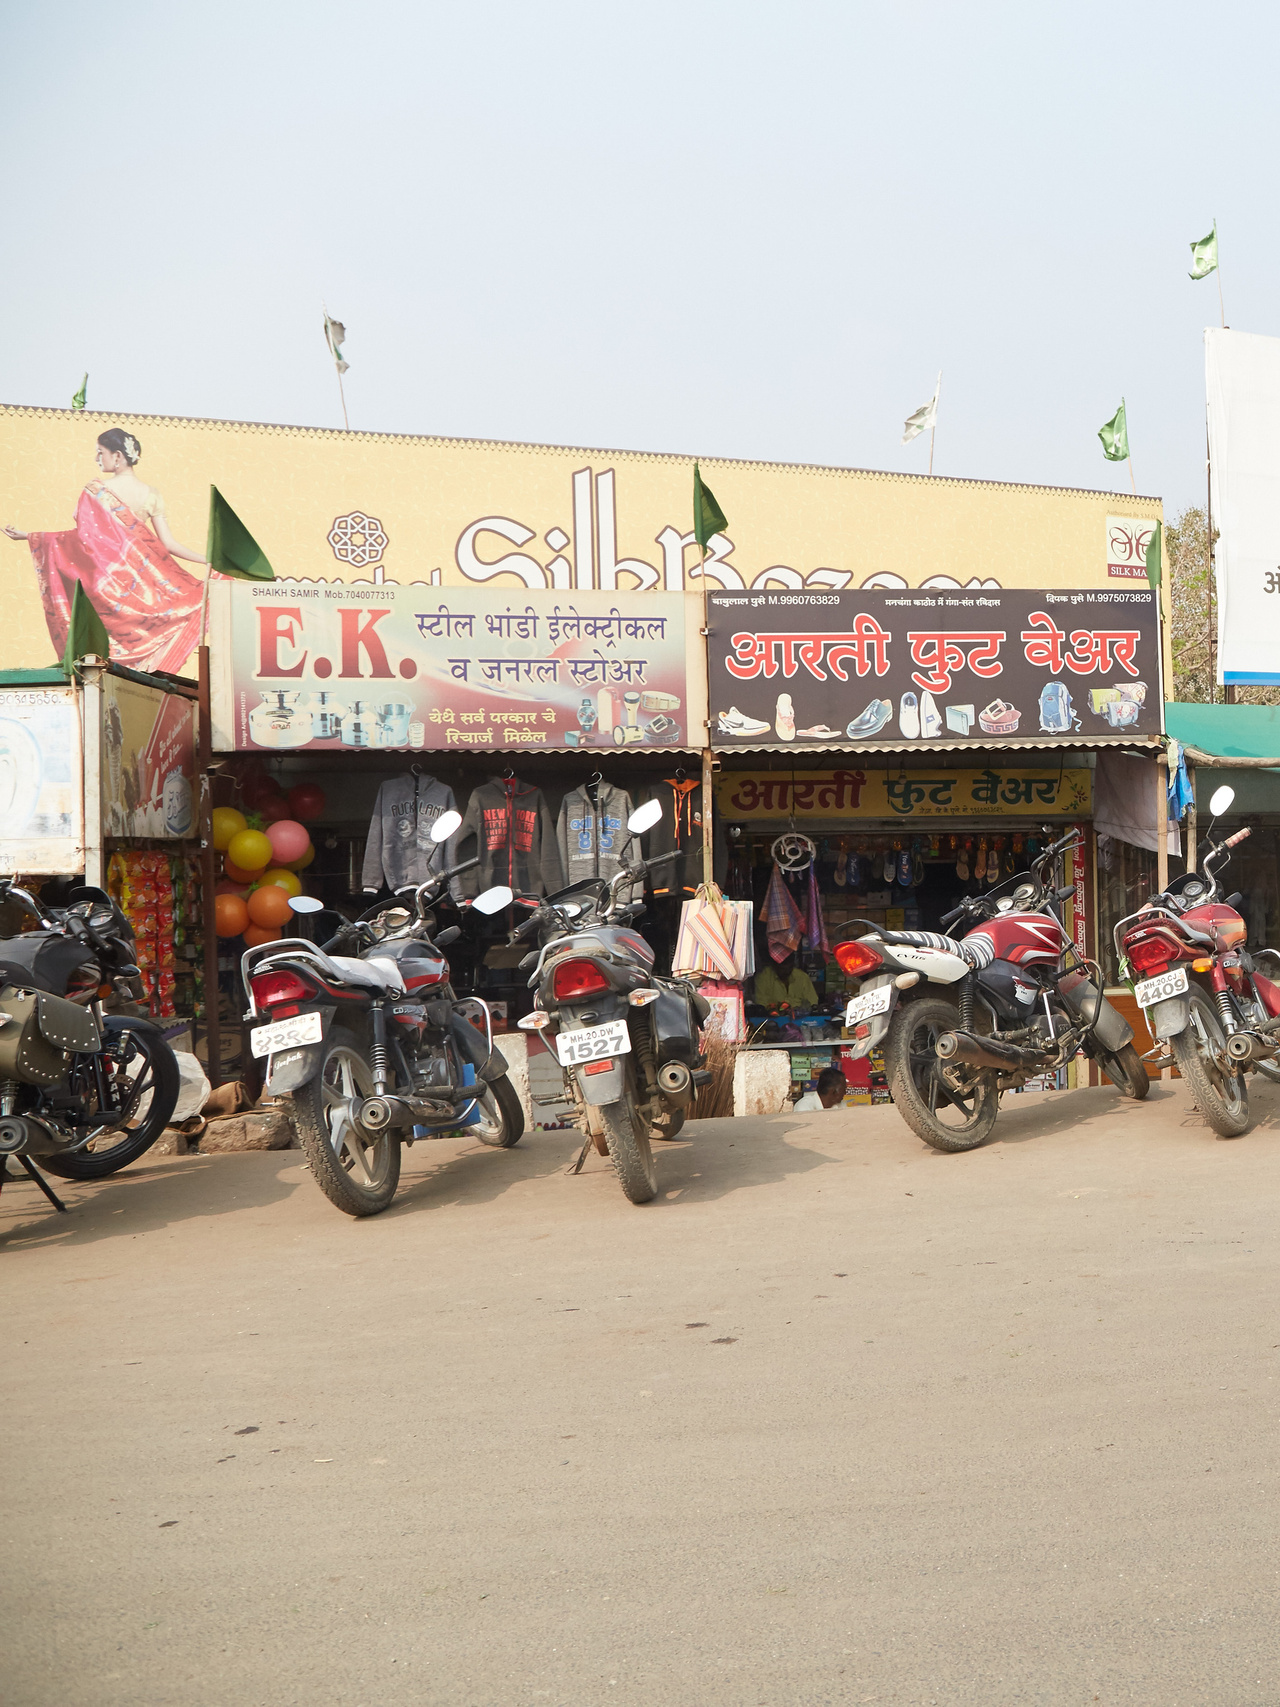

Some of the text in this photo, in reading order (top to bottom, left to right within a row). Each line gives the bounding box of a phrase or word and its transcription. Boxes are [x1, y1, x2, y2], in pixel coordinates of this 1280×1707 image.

[1111, 566, 1131, 576] SILK
[252, 587, 288, 598] SHAIKH
[290, 588, 320, 599] SAMIR
[414, 604, 668, 648] स्टील भांडी ईलेक्ट्रीकल
[255, 606, 418, 680] E.K.
[725, 610, 1141, 695] आरती फुट वेअर
[447, 649, 648, 684] व जनरल स्टोअर
[428, 708, 455, 725] येथे
[460, 708, 485, 726] सर्व
[541, 707, 556, 724] चे
[445, 728, 547, 745] रिचार्ज मिळेल
[971, 770, 1059, 805] वेअर
[483, 808, 506, 820] NEW
[1075, 920, 1084, 956] Paragon
[1140, 978, 1186, 1004] 4409
[848, 1000, 886, 1025] 8732
[564, 1035, 624, 1061] 1527
[570, 1027, 614, 1044] MH.20.DW
